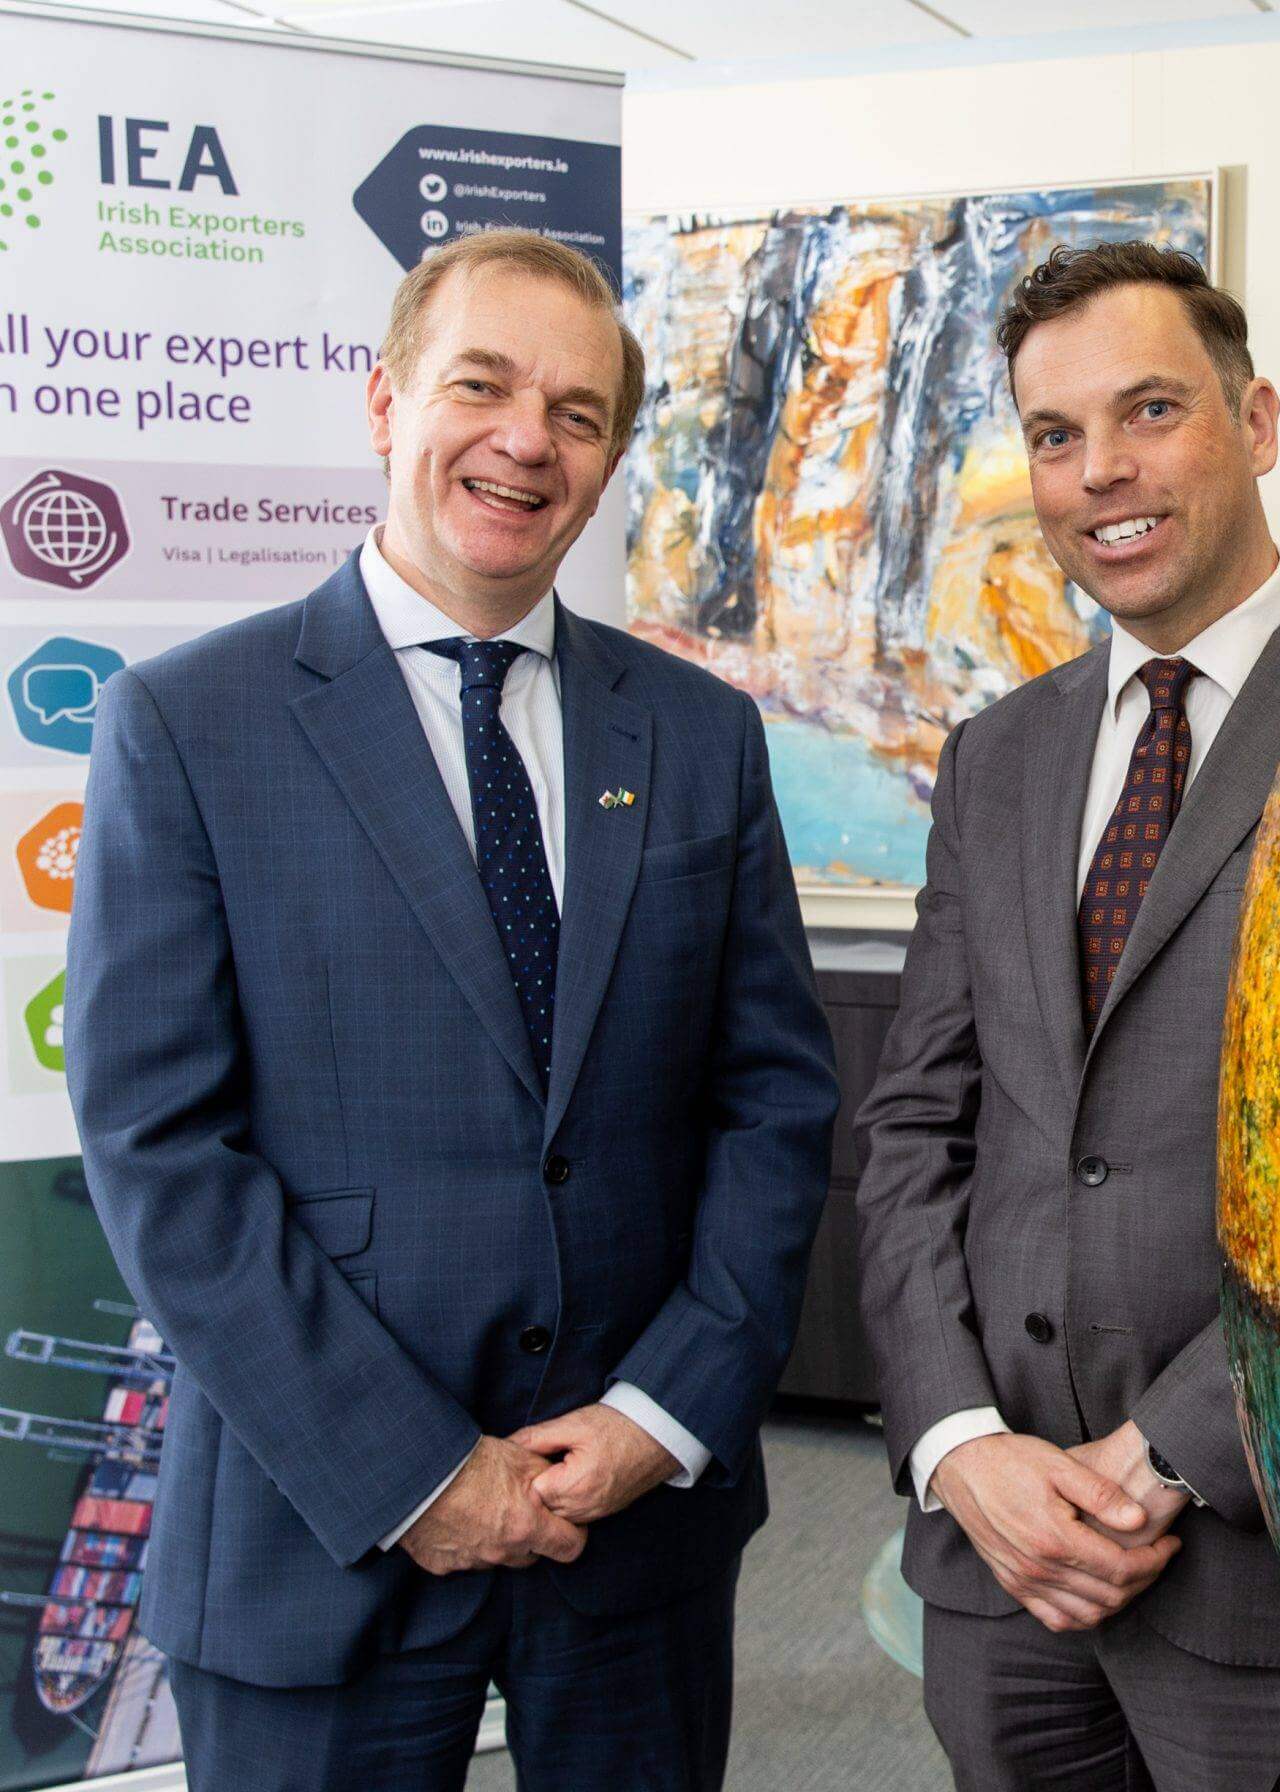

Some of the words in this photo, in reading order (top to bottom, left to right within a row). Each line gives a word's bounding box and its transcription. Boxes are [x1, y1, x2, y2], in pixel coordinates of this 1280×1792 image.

[98, 115, 240, 196] IEA
[418, 147, 569, 174] www.irishexporters.ie
[98, 200, 160, 226] Irish
[169, 206, 306, 238] Exporters
[98, 231, 264, 263] Association
[0, 313, 29, 354] ll
[44, 326, 152, 368] your
[165, 332, 310, 377] expert
[322, 332, 381, 373] kn
[33, 384, 121, 418] one
[136, 380, 252, 430] place
[161, 495, 249, 523] Trade
[257, 498, 378, 525] Services
[163, 547, 202, 562] Visa
[218, 547, 328, 566] Legalisation
